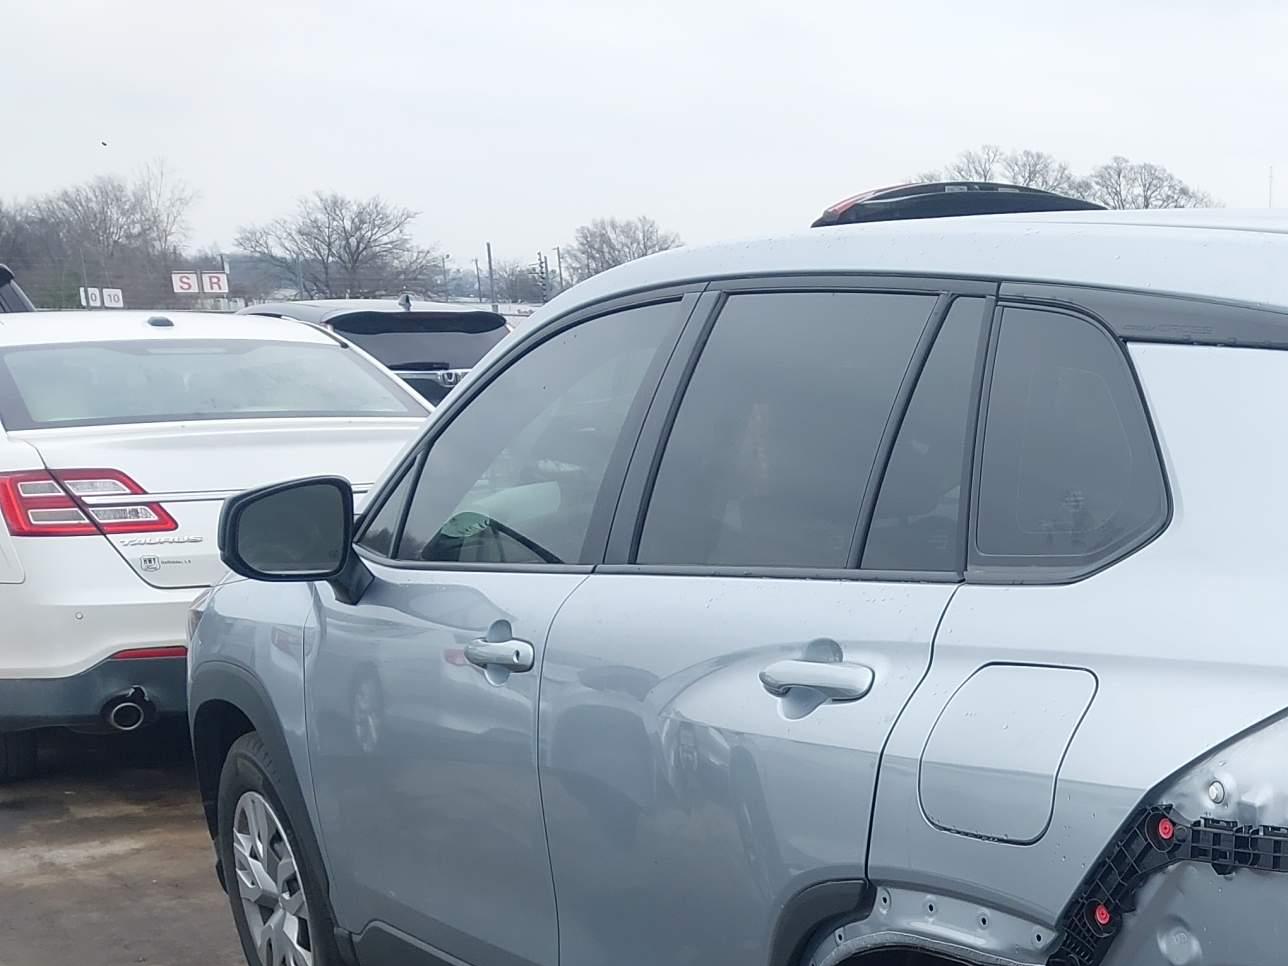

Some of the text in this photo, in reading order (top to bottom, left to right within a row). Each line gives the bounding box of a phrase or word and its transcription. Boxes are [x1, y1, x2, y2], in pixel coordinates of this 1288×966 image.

[178, 275, 193, 291] S
[208, 275, 223, 291] R
[119, 535, 204, 547] TAURUS
